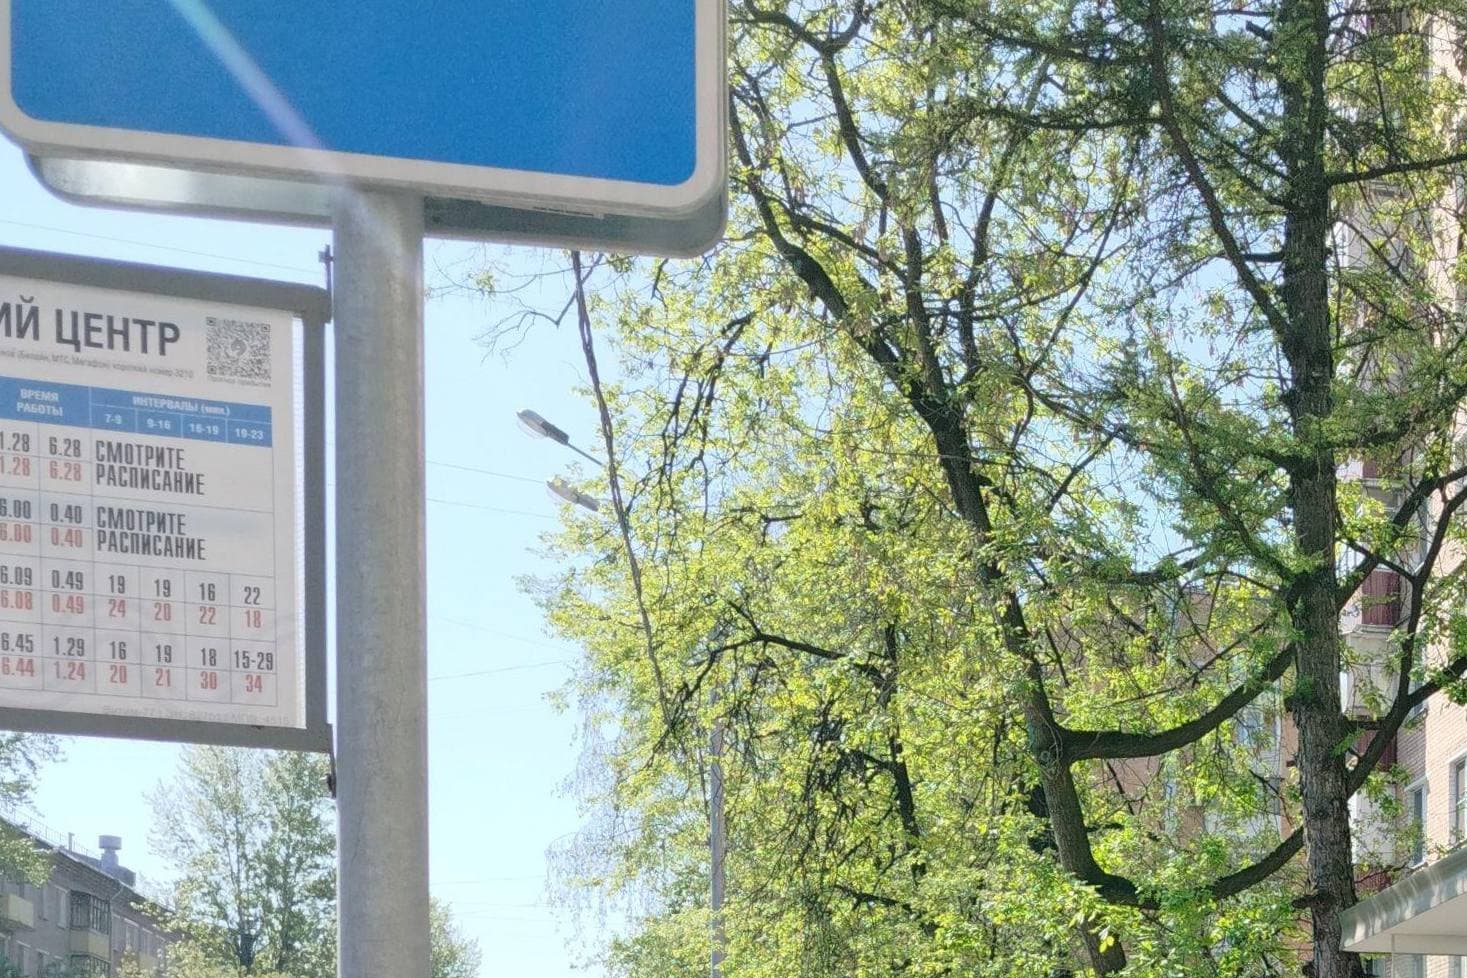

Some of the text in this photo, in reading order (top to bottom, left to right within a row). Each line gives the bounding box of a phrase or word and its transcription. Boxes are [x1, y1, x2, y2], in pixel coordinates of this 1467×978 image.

[55, 308, 181, 357] ЦЕНТР
[16, 401, 64, 417] РАБОТЫ
[20, 388, 60, 401] ВРЕМЯ
[132, 395, 199, 414] ИНТЕРВАЛЫ
[49, 436, 81, 458] 6.28
[95, 440, 185, 471] СМОТРИТЕ
[49, 460, 82, 482] 6.28
[96, 463, 205, 496] РАСПИСАНИЕ
[50, 503, 82, 525] 0.40
[97, 506, 187, 536] СМОТРИТЕ
[51, 527, 83, 548] 0.40
[97, 530, 206, 561] РАСПИСАНИЕ
[0, 565, 261, 605] 6.09 0.49 19 19 16 22
[52, 594, 84, 615] 0.49
[108, 599, 126, 618] 24
[154, 603, 172, 621] 20
[200, 607, 217, 625] 22
[245, 611, 262, 629] 18
[1, 632, 274, 671] 6.45 1.29 16 19 18 15-29
[1, 656, 263, 693] 6.44 1.24 20 21 30 34
